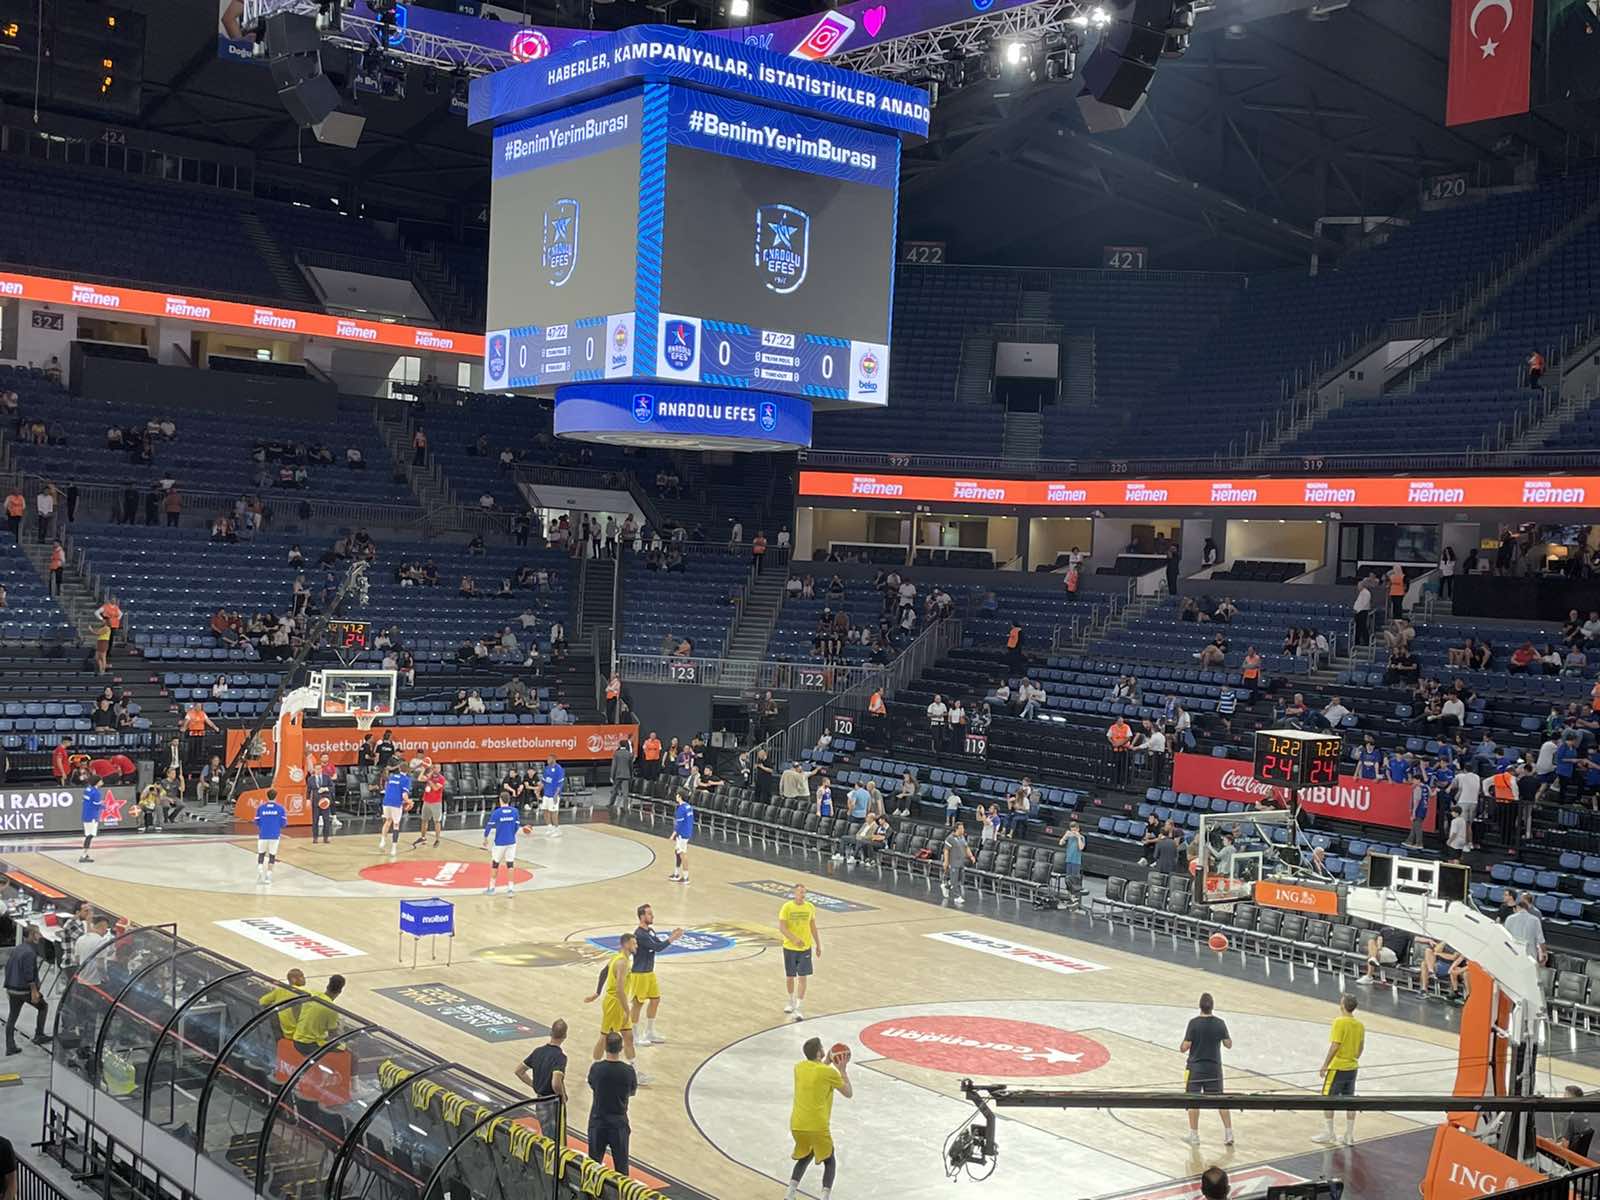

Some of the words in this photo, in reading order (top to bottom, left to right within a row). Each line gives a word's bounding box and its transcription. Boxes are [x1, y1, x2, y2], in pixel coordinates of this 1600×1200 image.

[548, 53, 610, 86] HABERLER,
[614, 42, 752, 80] KAMPANYALAR,
[759, 63, 876, 108] İSTATİSTİKLER
[504, 113, 629, 162] #BenimYerimBurası
[688, 109, 878, 171] #BenimYerimBurası
[1433, 179, 1465, 199] 420
[906, 247, 942, 264] 422
[1110, 252, 1143, 269] 421
[767, 261, 796, 275] EFES
[72, 290, 120, 307] Hemen
[165, 303, 211, 318] Hemen
[33, 314, 63, 330] 324
[253, 314, 297, 329] Hemen
[336, 325, 377, 340] Hemen
[763, 333, 793, 348] 47:22
[415, 336, 453, 349] Hemen
[586, 337, 594, 361] 0
[519, 345, 527, 369] 0
[718, 341, 731, 366] 0
[822, 355, 834, 379] 0
[658, 402, 722, 420] ANADOLU
[725, 406, 756, 422] EFES
[852, 482, 903, 496] Hemen
[953, 487, 1005, 500] Hemen
[1047, 489, 1087, 502] Hemen
[1125, 488, 1168, 502] Hemen
[1211, 488, 1257, 502] Hemen
[1304, 488, 1356, 502] Hemen
[1408, 488, 1464, 503] Hemen
[1523, 488, 1585, 503] Hemen
[671, 668, 695, 680] 123
[799, 673, 824, 687] 122
[834, 720, 853, 735] 120
[481, 736, 577, 751] #basketbolunrengi
[966, 738, 986, 754] 119
[1262, 755, 1292, 780] 24
[1310, 760, 1334, 784] 24
[11, 792, 73, 809] RADIO
[1275, 888, 1301, 904] ING
[1448, 1162, 1498, 1195] ING
